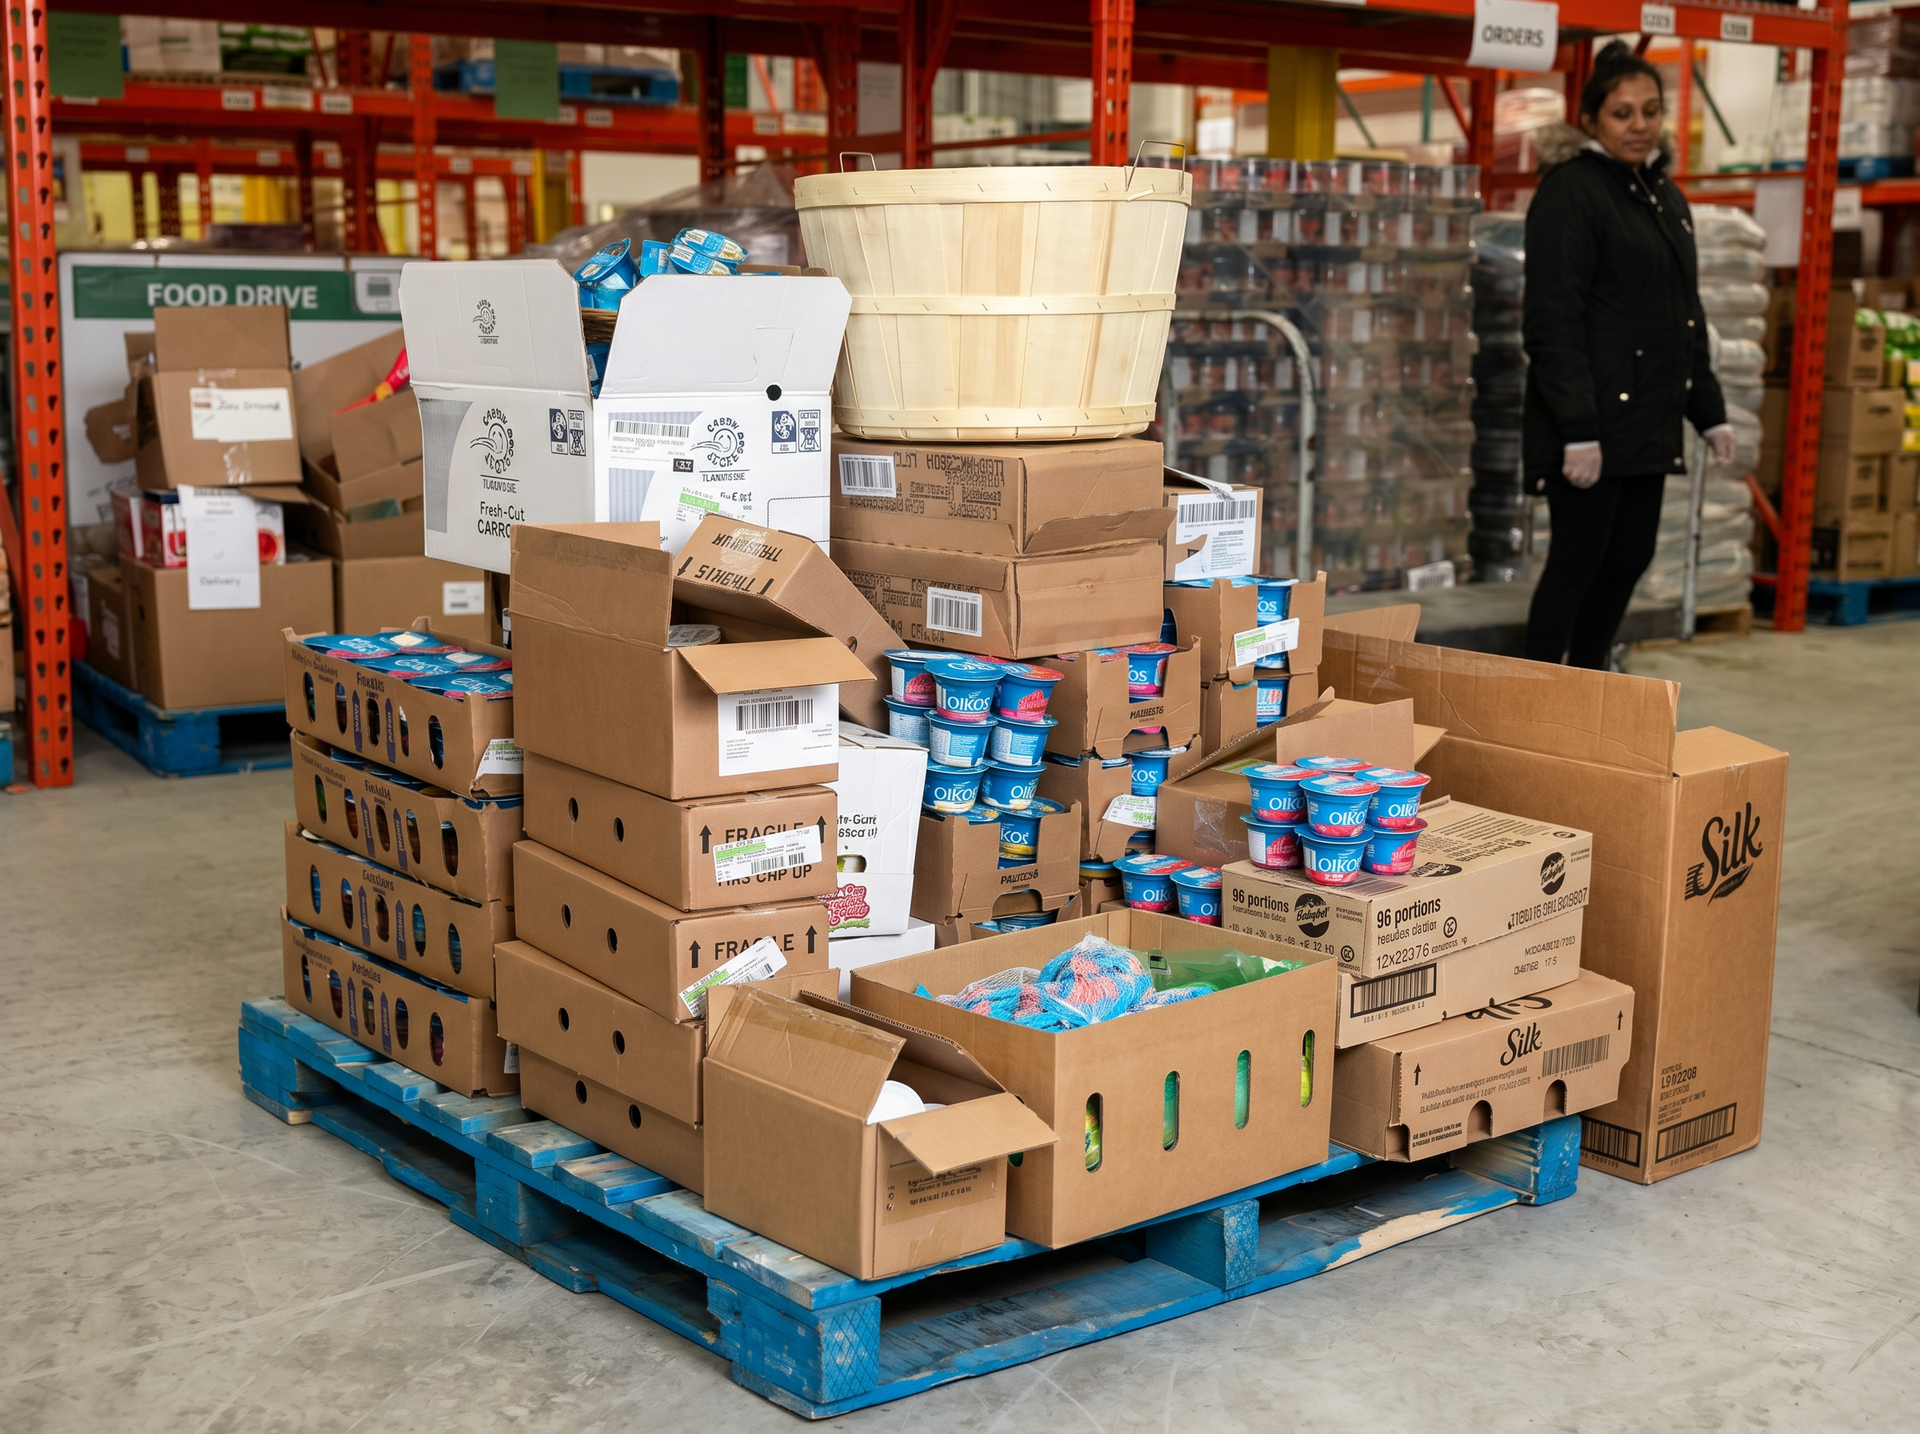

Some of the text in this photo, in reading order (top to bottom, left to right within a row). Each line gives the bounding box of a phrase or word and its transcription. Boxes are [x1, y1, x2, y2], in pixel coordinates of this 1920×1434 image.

[1482, 24, 1544, 48] ORDERS
[147, 283, 318, 309] FOOD DRIVE
[480, 501, 525, 521] Fresh-Cut
[947, 696, 990, 711] OIKOS
[1692, 802, 1763, 897] Silk
[792, 864, 812, 879] UP
[1232, 888, 1289, 913] 96 portions
[1376, 898, 1441, 929] 96 portions
[1376, 942, 1430, 970] 12x22376
[1499, 1022, 1543, 1067] Silk
